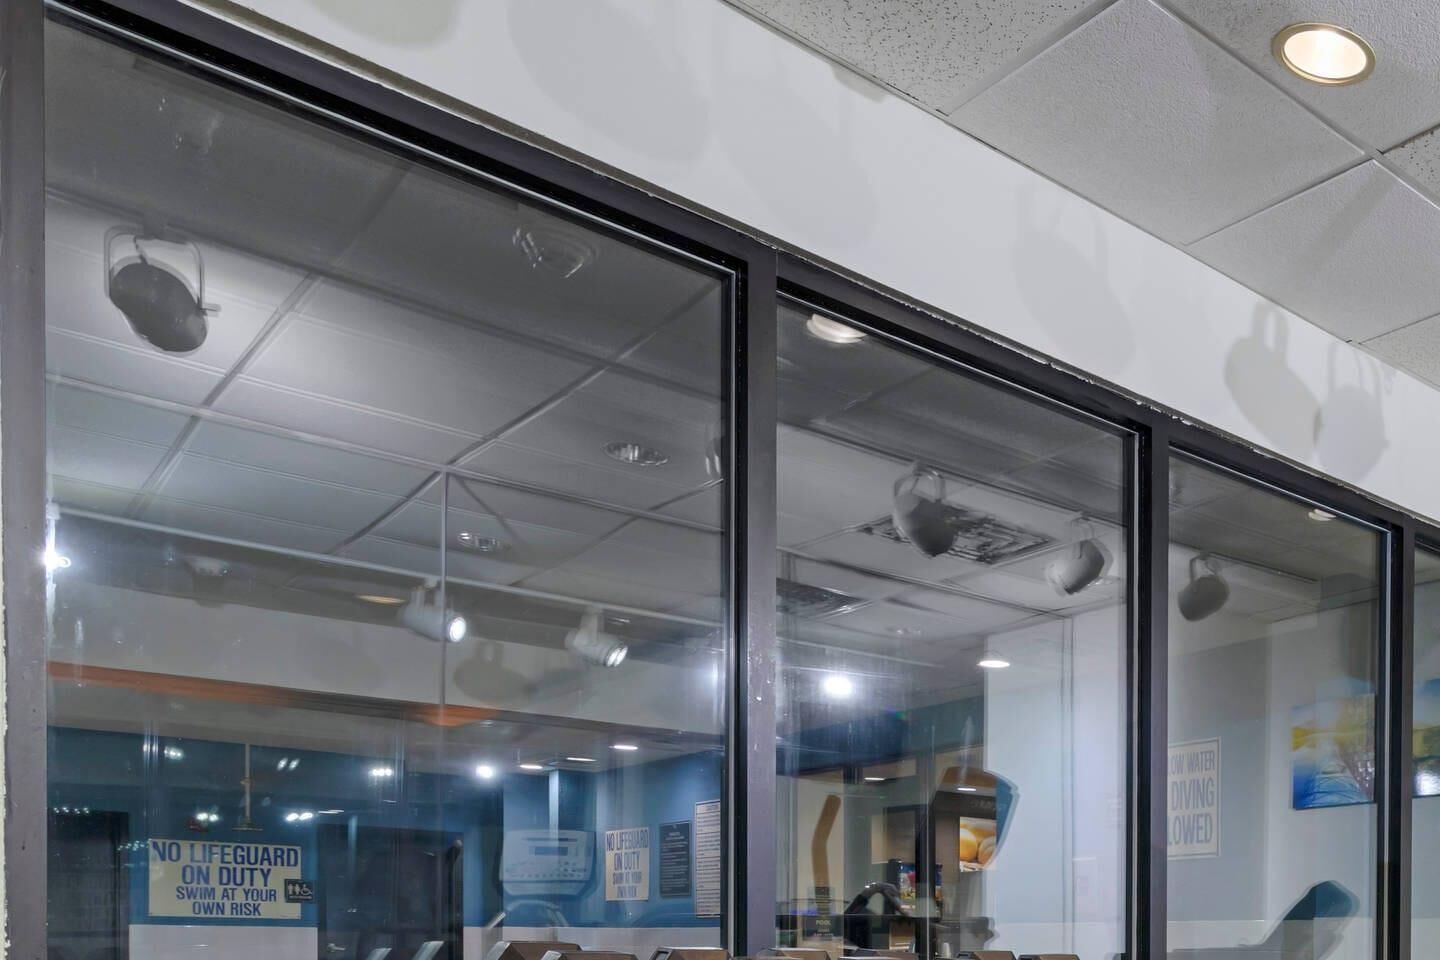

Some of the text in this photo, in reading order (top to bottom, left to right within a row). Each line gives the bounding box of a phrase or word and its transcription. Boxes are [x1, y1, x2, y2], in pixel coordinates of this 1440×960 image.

[1171, 775, 1215, 811] DIVING
[1168, 812, 1213, 846] OWED
[606, 830, 615, 852] NO
[152, 841, 299, 867] NO LIFEGUARD
[181, 864, 272, 887] ON DUTY
[176, 885, 277, 903] SWIM AT YOUR
[192, 902, 262, 917] OWN RISK
